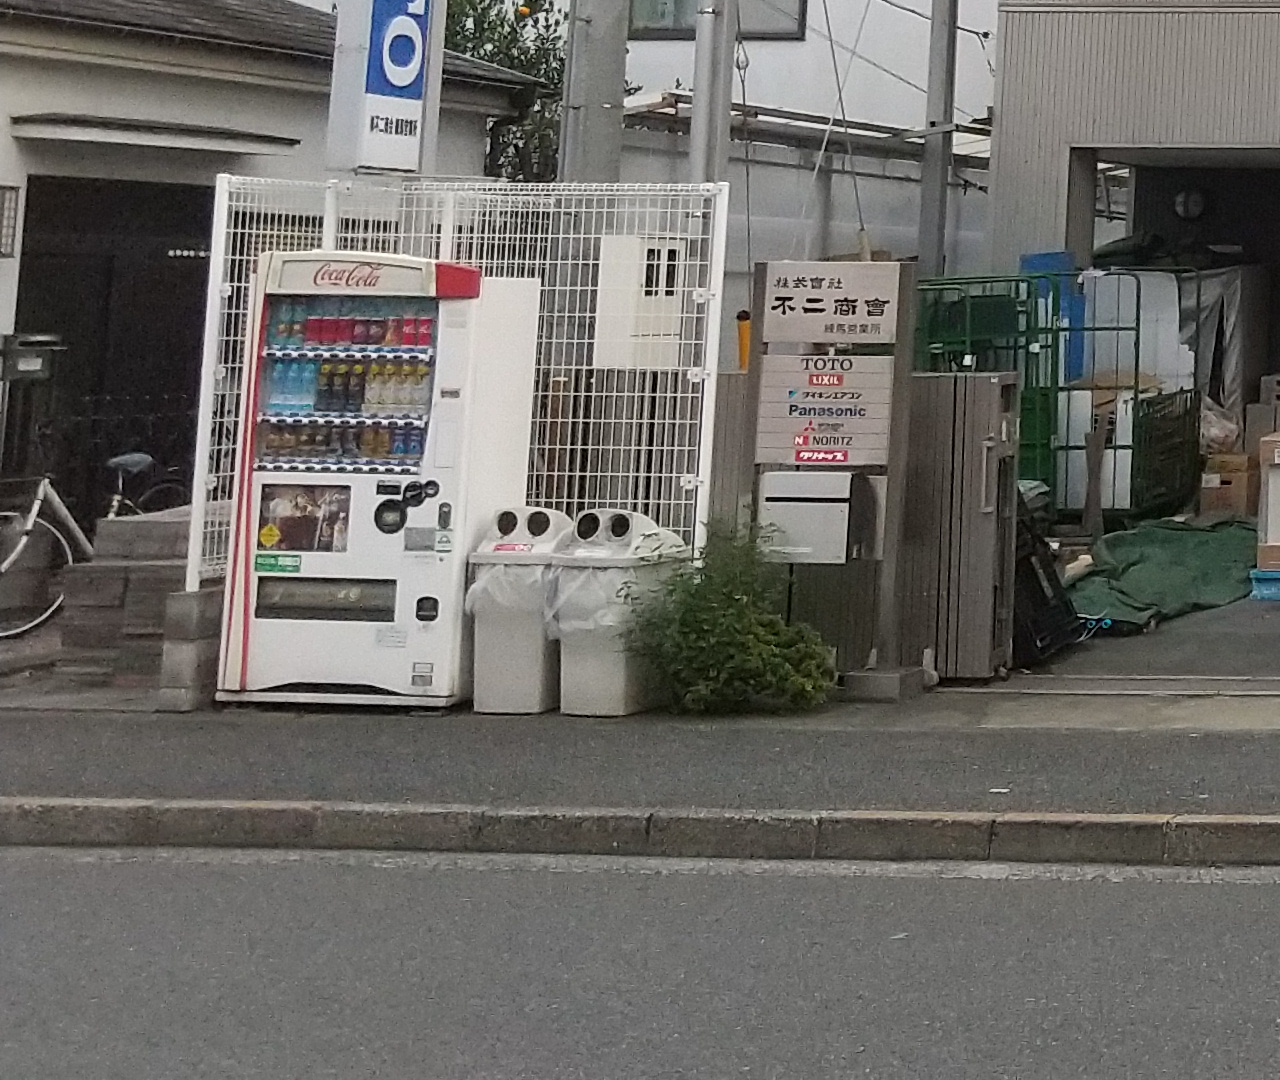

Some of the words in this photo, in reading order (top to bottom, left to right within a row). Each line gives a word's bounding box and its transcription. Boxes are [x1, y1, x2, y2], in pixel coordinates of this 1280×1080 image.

[801, 357, 853, 371] TOTO
[812, 375, 840, 385] LIXIL
[788, 404, 867, 417] Panasonic
[812, 435, 853, 446] NORITZ
